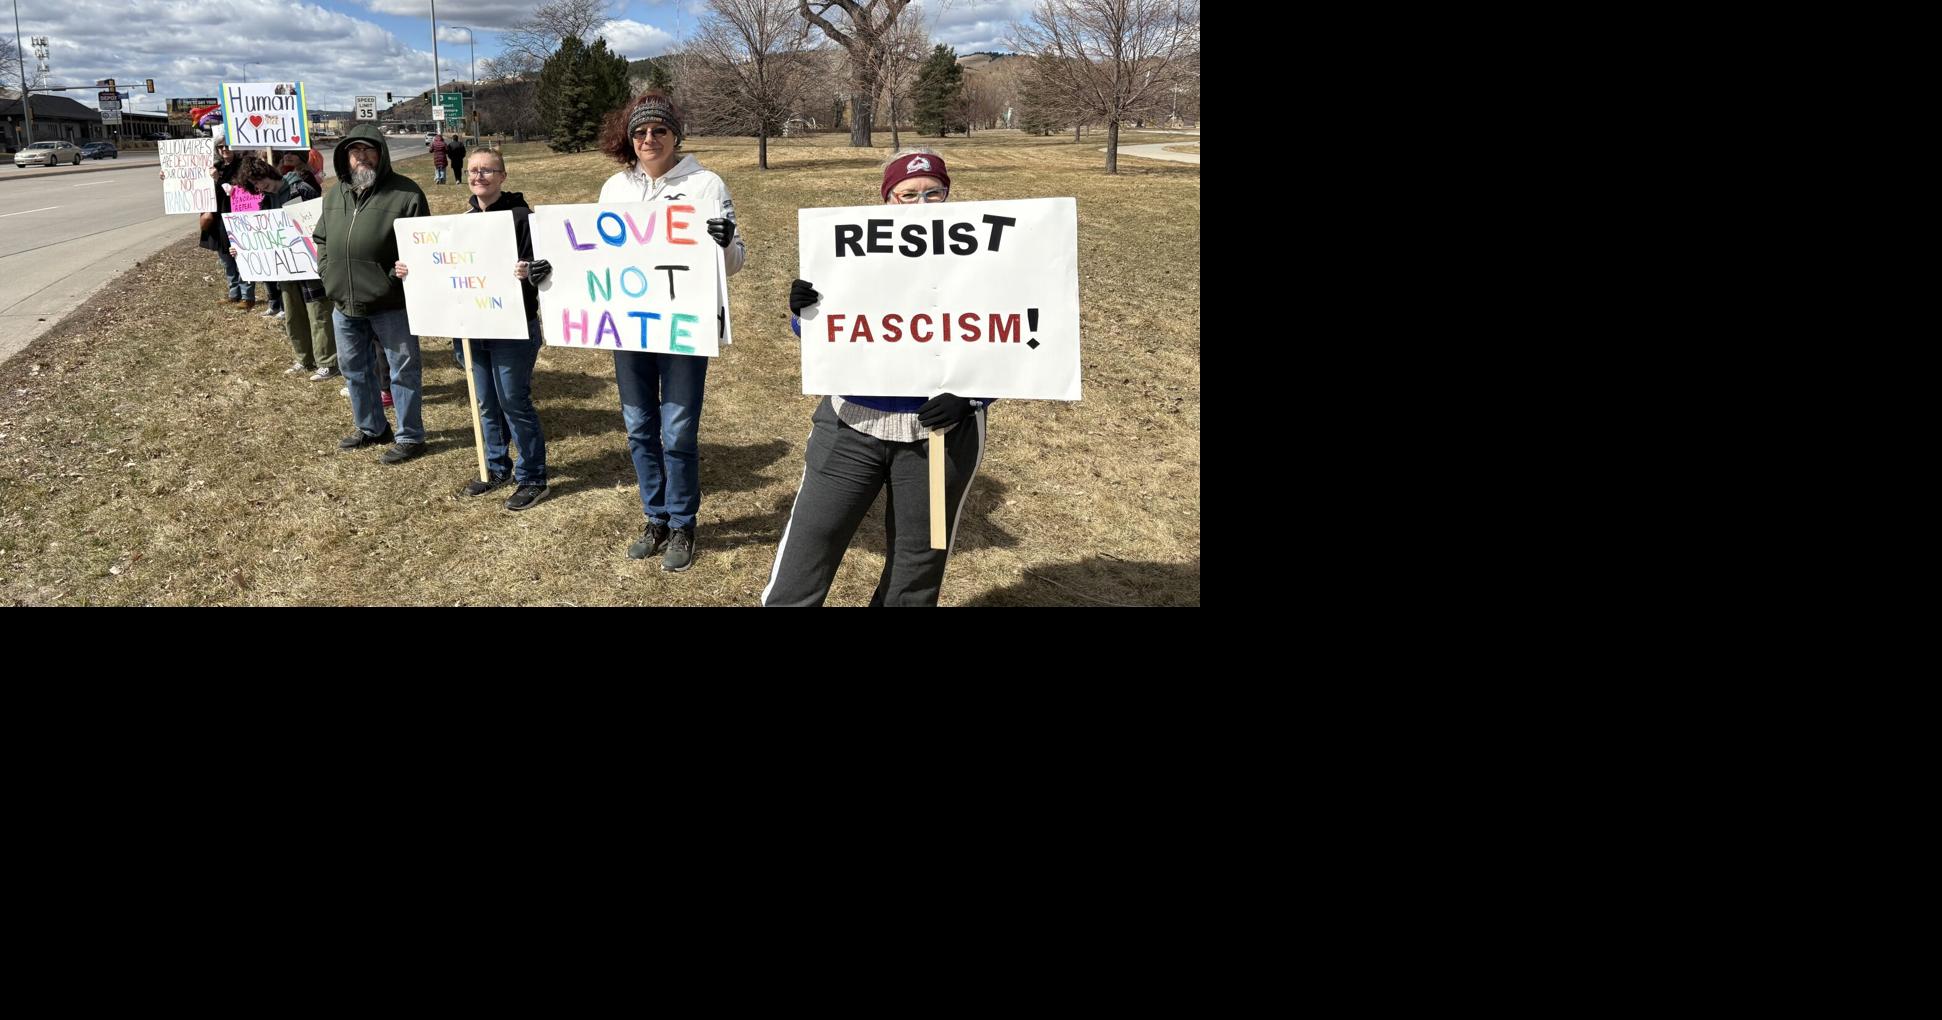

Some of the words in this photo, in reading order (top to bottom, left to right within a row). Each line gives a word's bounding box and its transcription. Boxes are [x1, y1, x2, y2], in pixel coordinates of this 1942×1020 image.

[228, 86, 295, 113] Human
[360, 109, 374, 118] 35
[234, 116, 300, 145] Kind!
[160, 138, 213, 155] BILLIONAIRES
[162, 155, 173, 168] ARE
[174, 154, 213, 168] DESTROYING
[177, 167, 207, 180] COUNTRY
[180, 179, 195, 192] NOT
[165, 191, 191, 213] TRANS
[191, 188, 217, 211] YOUTH
[224, 213, 257, 232] TRANS
[253, 211, 272, 231] JOY
[563, 204, 699, 251] LOVE
[412, 231, 441, 245] STAY
[834, 213, 1017, 258] RESIST
[240, 251, 272, 277] YOU
[274, 247, 307, 276] ALL
[432, 251, 477, 265] SILENT
[450, 275, 487, 289] THEY
[586, 264, 690, 303] NOT
[475, 296, 503, 310] WIN
[561, 307, 700, 354] HATE
[826, 307, 1041, 350] FASCISM!
